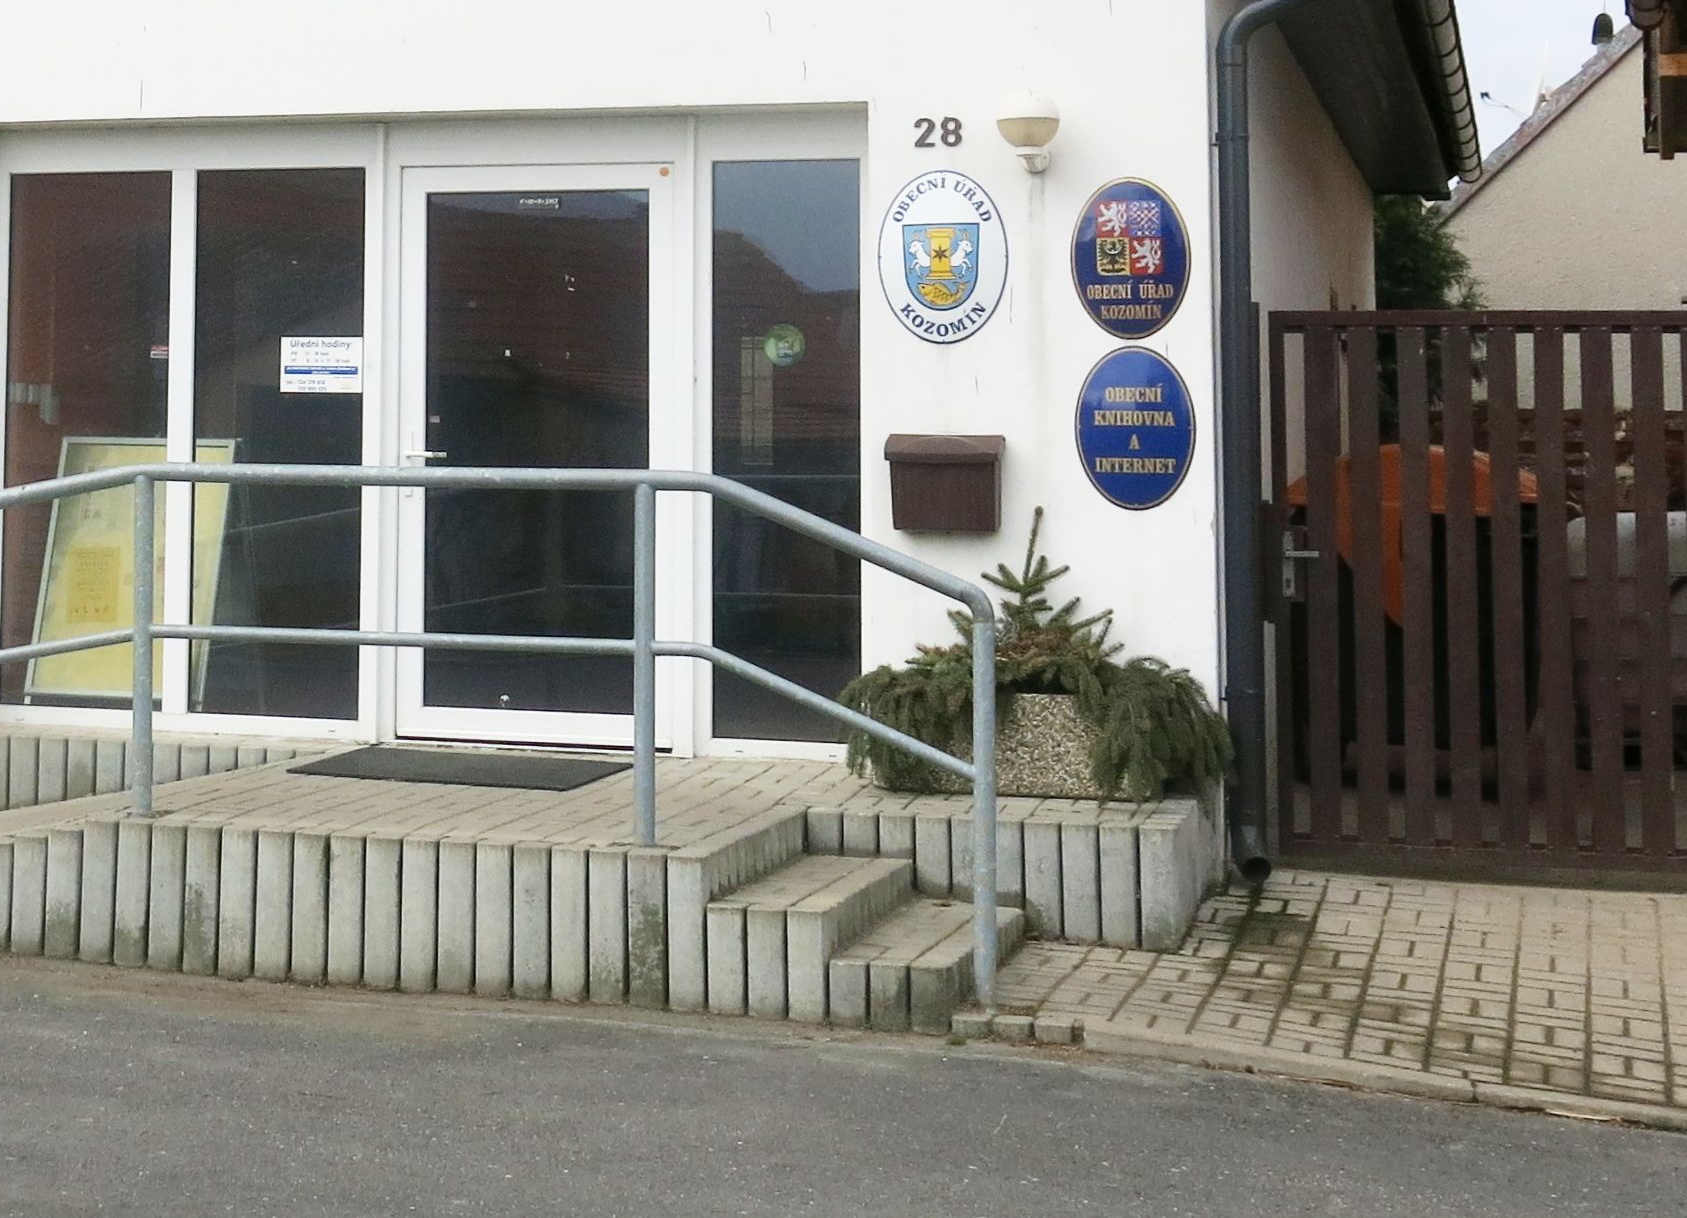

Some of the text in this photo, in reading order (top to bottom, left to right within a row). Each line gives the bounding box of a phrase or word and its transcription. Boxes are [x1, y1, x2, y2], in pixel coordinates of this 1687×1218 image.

[913, 116, 962, 148] 28
[892, 174, 992, 223] OBECNÍ ÚŘAD
[1086, 280, 1174, 299] OBECNÍ ÚŘAD
[900, 301, 987, 338] KOZOMÍN
[1100, 302, 1162, 320] KOZOMÍN
[1105, 384, 1162, 403] OBECNÍ
[1094, 410, 1175, 427] KNIHOVNA
[1128, 433, 1141, 450] A
[1095, 458, 1176, 474] INTERNET
